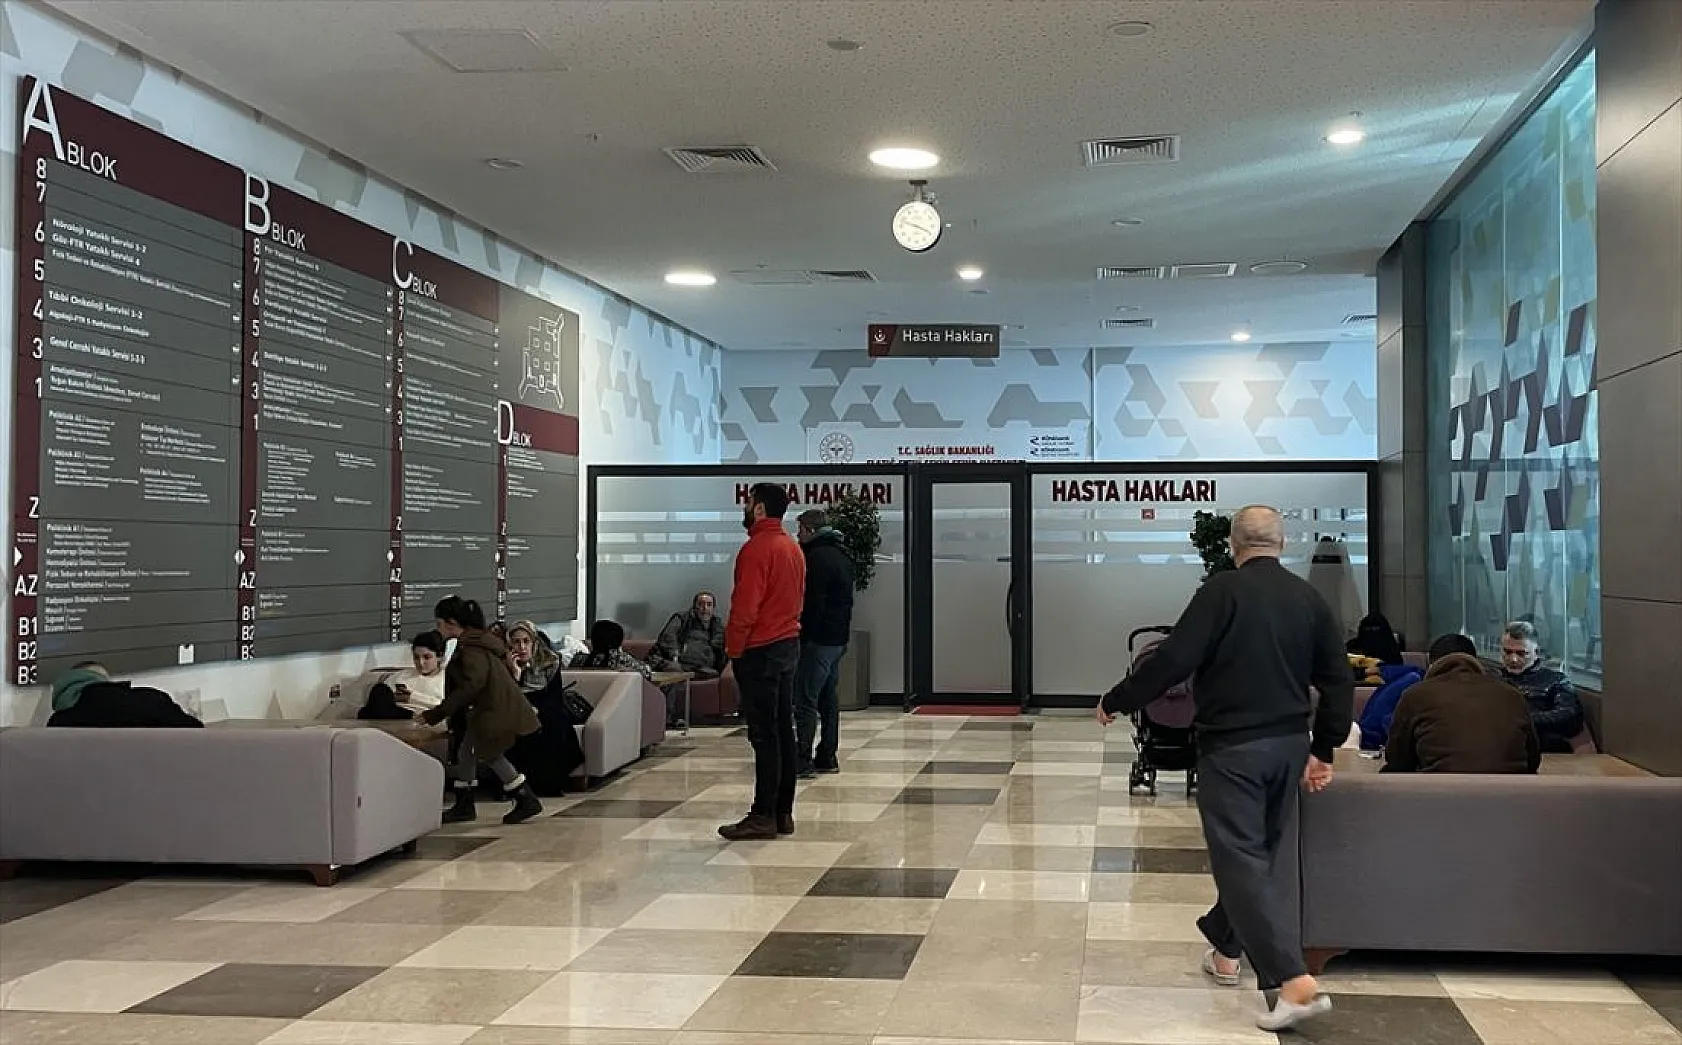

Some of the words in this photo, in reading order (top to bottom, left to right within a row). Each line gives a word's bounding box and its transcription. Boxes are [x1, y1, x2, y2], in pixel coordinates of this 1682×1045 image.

[24, 75, 65, 161] A
[66, 141, 117, 180] BLOK
[36, 156, 47, 179] 8
[36, 181, 46, 203] 7
[245, 171, 271, 235] B
[272, 222, 306, 251] BLOK
[34, 221, 45, 242] 6
[253, 238, 260, 256] 8
[34, 258, 45, 281] 5
[253, 257, 260, 275] 7
[393, 236, 413, 289] C
[413, 276, 438, 299] BLOK
[252, 288, 260, 305] 6
[399, 291, 404, 304] 8
[33, 299, 44, 321] 4
[398, 307, 403, 321] 7
[252, 320, 260, 337] 5
[902, 328, 941, 342] Hasta
[944, 328, 993, 342] Hakları
[32, 337, 43, 359] 3
[397, 333, 403, 347] 6
[251, 352, 259, 368] 4
[397, 359, 403, 373] 5
[34, 377, 42, 398] 1
[251, 381, 259, 399] 3
[397, 386, 403, 400] 4
[253, 414, 259, 431] 1
[397, 410, 403, 425] 3
[498, 399, 514, 445] D
[513, 430, 533, 448] BLOK
[898, 445, 912, 455] T.C.
[915, 444, 945, 455] SAĞLIK
[948, 444, 995, 455] BAKANLIĞI
[1052, 480, 1121, 502] HASTA
[1125, 480, 1217, 502] HAKLARI
[28, 496, 39, 518] Z
[14, 574, 38, 597] AZ
[239, 571, 256, 589] AZ
[242, 605, 256, 621] B1
[19, 616, 38, 636] B1
[18, 642, 37, 661] B2
